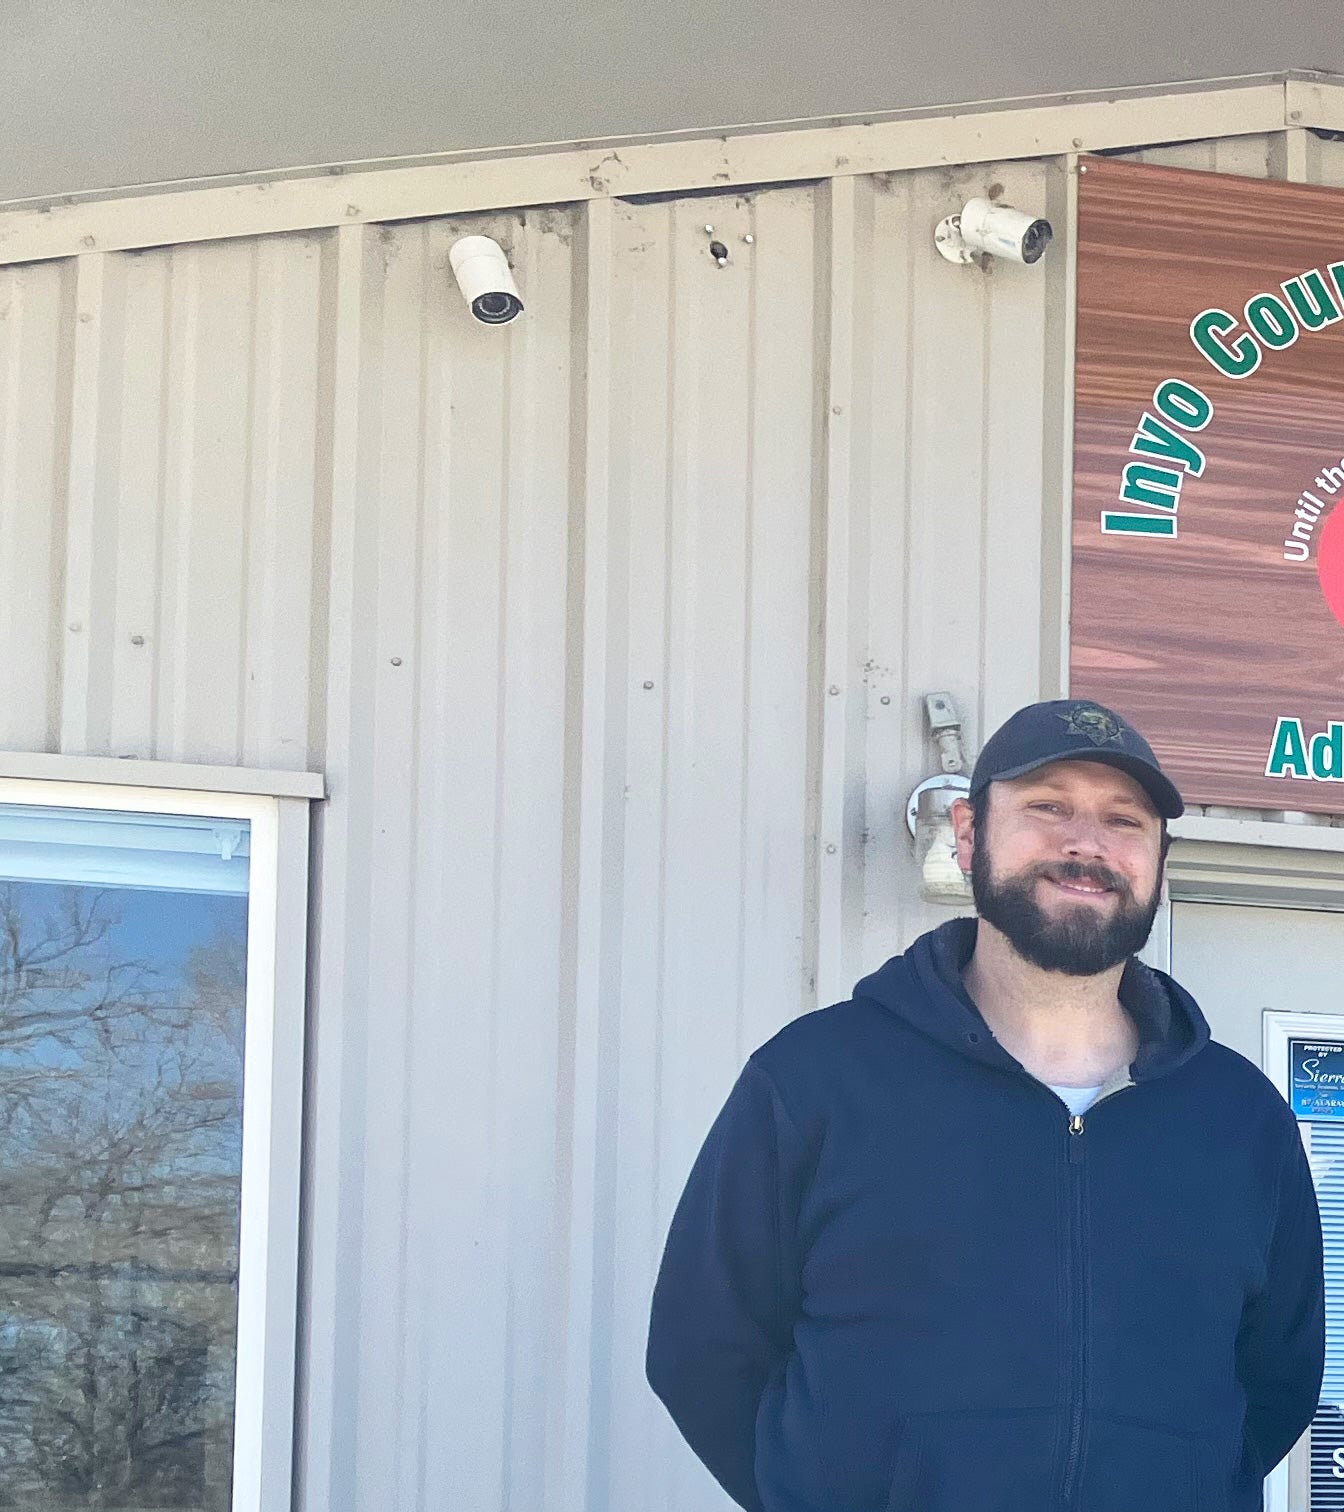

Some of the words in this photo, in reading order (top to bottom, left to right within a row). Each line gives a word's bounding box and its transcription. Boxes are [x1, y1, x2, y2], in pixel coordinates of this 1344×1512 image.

[1101, 378, 1214, 538] Inyo
[1283, 490, 1326, 562] Until
[1303, 1045, 1343, 1053] PROTECTED
